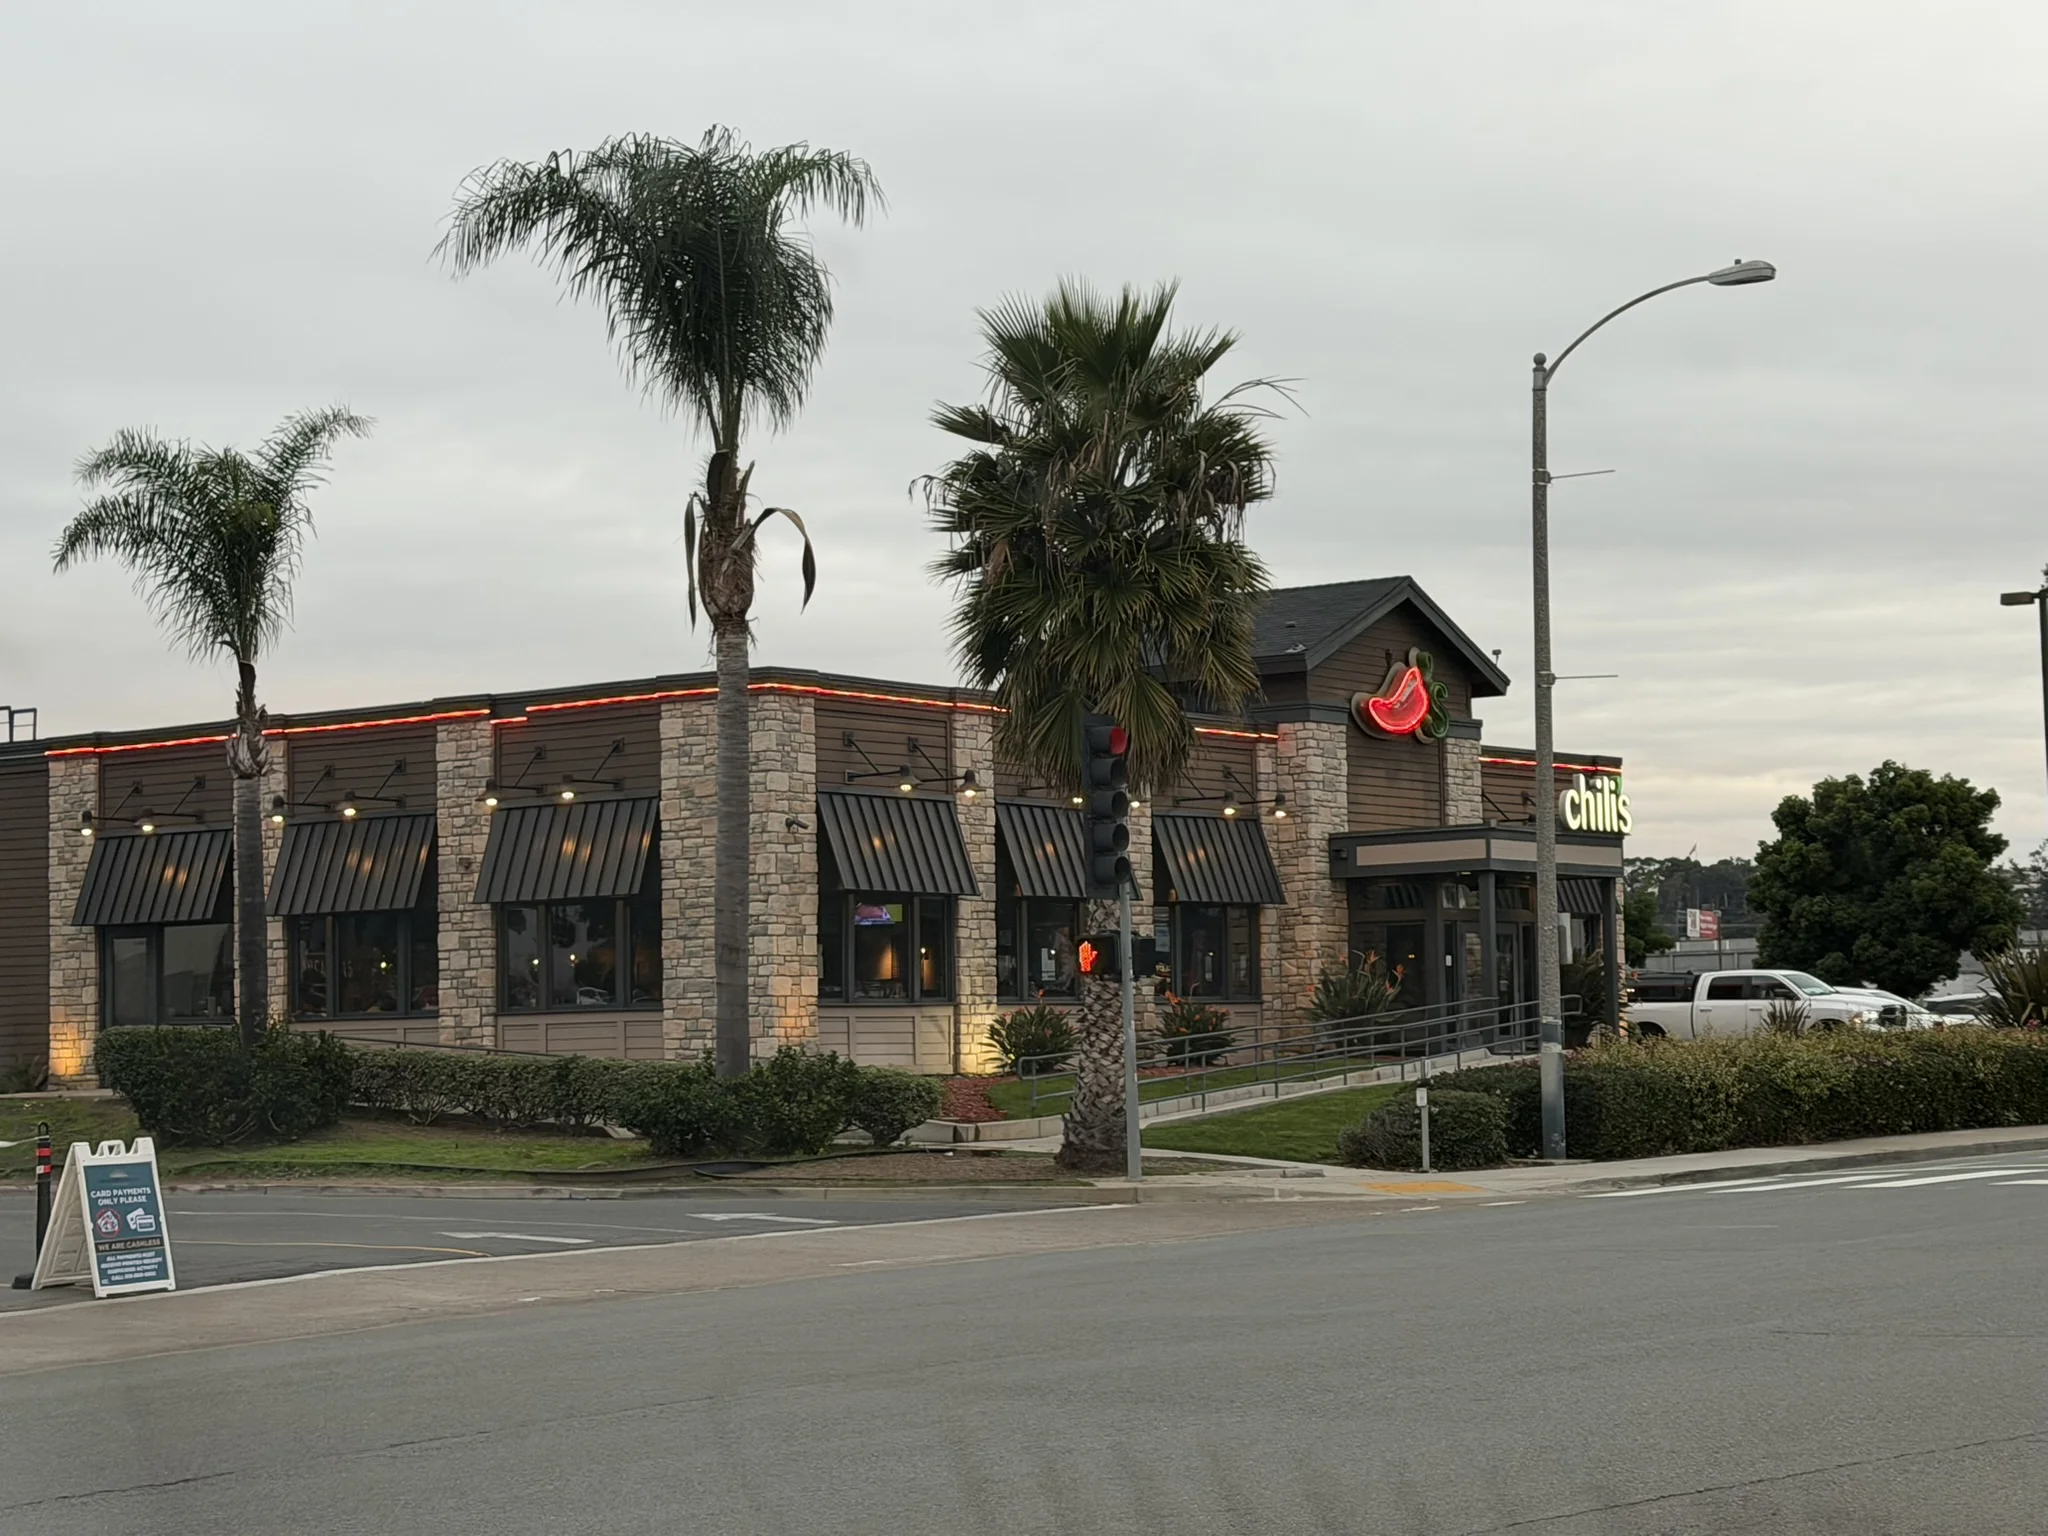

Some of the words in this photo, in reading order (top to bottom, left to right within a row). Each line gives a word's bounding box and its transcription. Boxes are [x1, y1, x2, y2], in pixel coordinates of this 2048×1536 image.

[90, 1190, 111, 1198] CARD
[113, 1187, 151, 1195] PAYMENTS
[98, 1198, 117, 1206] ONLY
[120, 1195, 147, 1203] PLEASE
[98, 1243, 110, 1251] WE
[111, 1241, 126, 1249] ARE
[126, 1239, 161, 1247] CASHLESS
